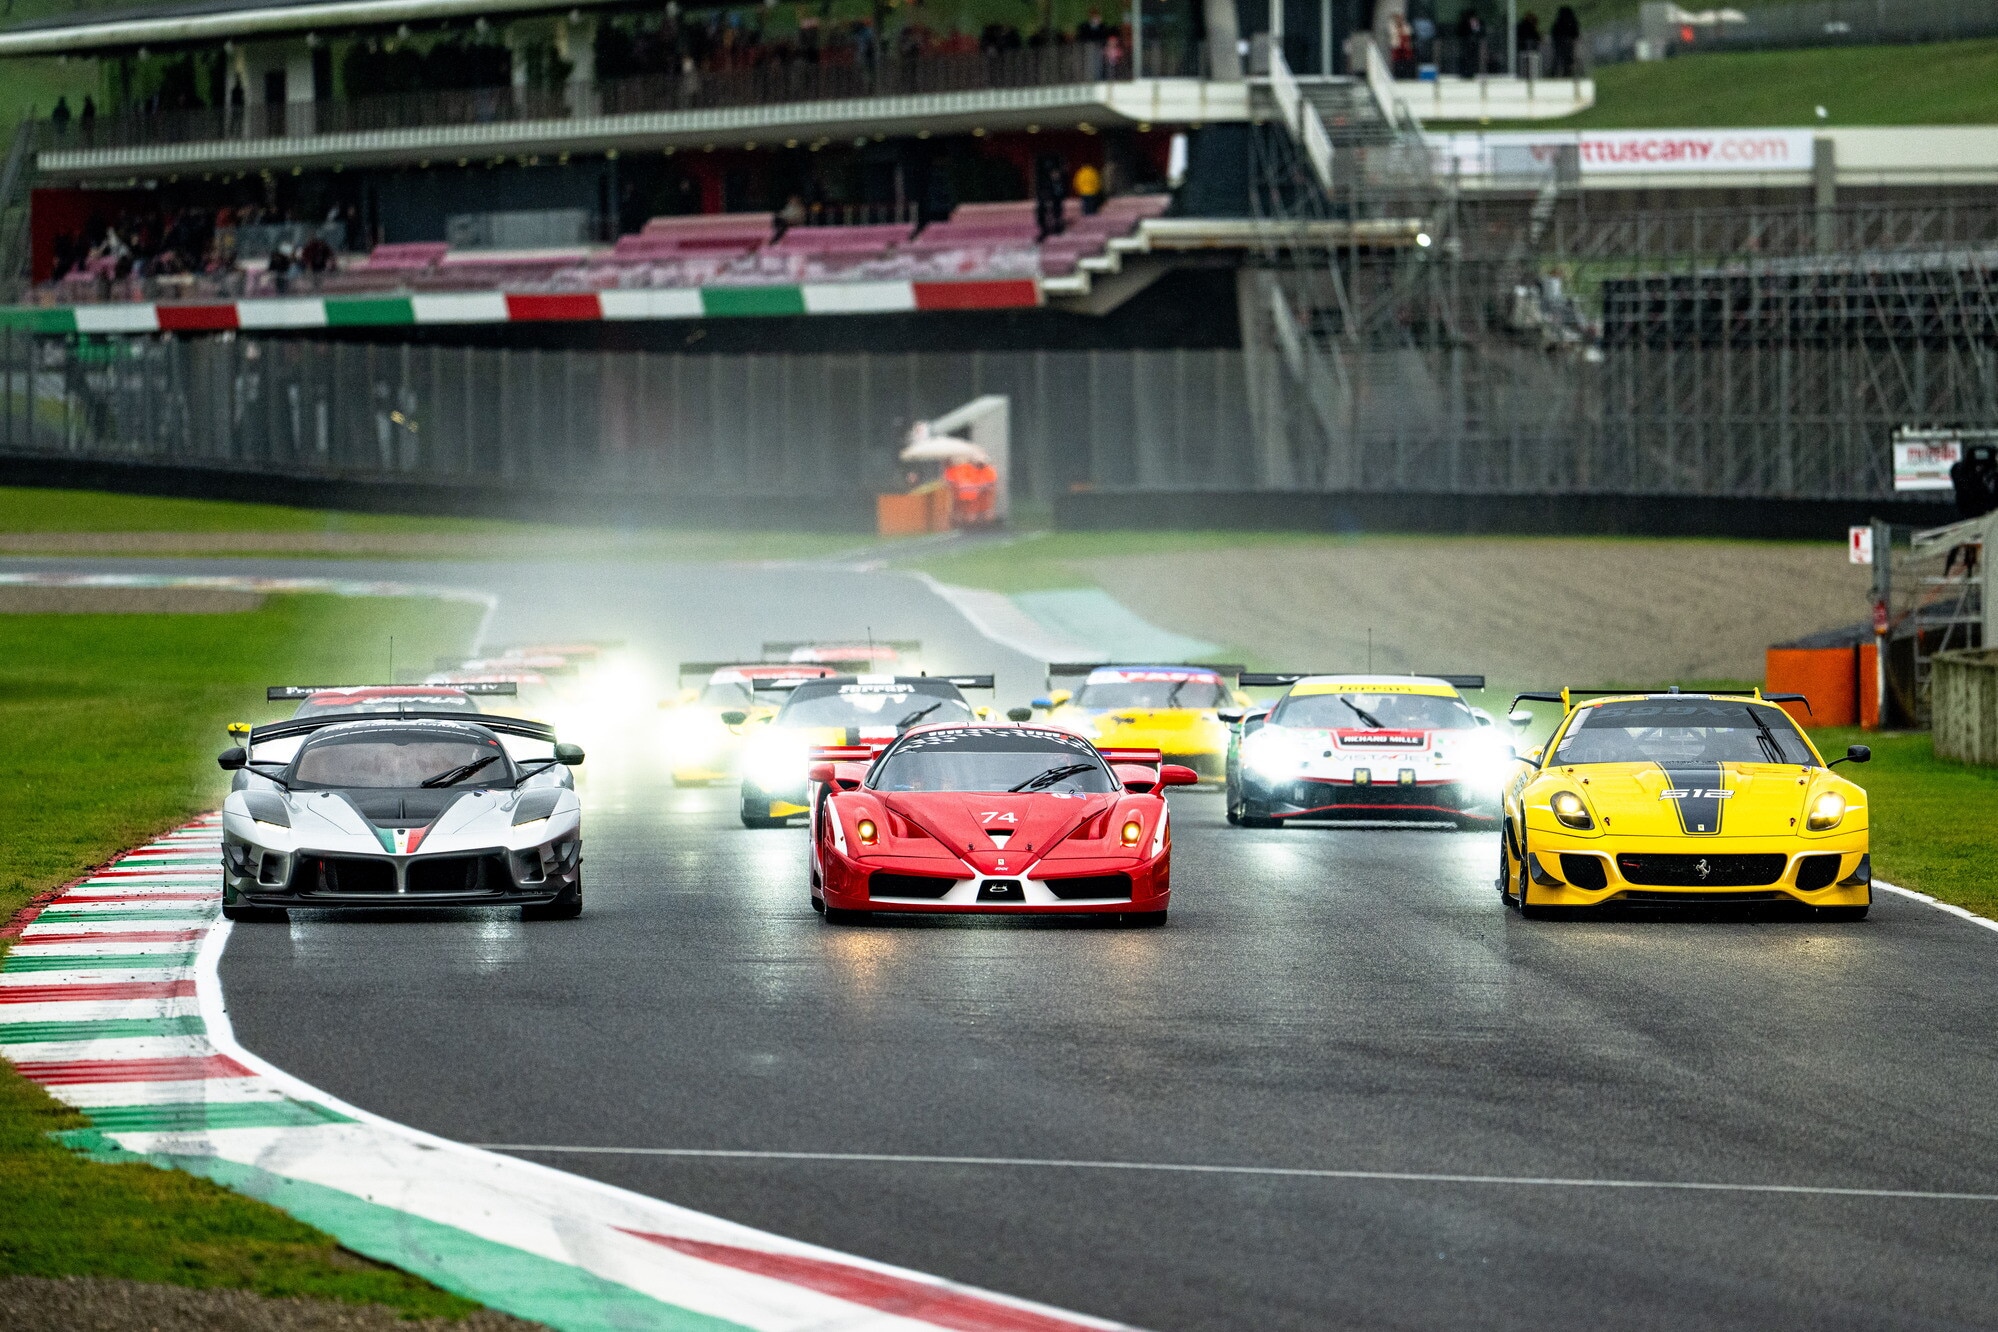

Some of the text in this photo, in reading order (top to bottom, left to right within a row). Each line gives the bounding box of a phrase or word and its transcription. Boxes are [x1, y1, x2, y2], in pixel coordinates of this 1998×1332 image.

[1343, 735, 1419, 744] RICHARD MILLE
[1658, 788, 1735, 800] 512
[980, 811, 1019, 824] 74
